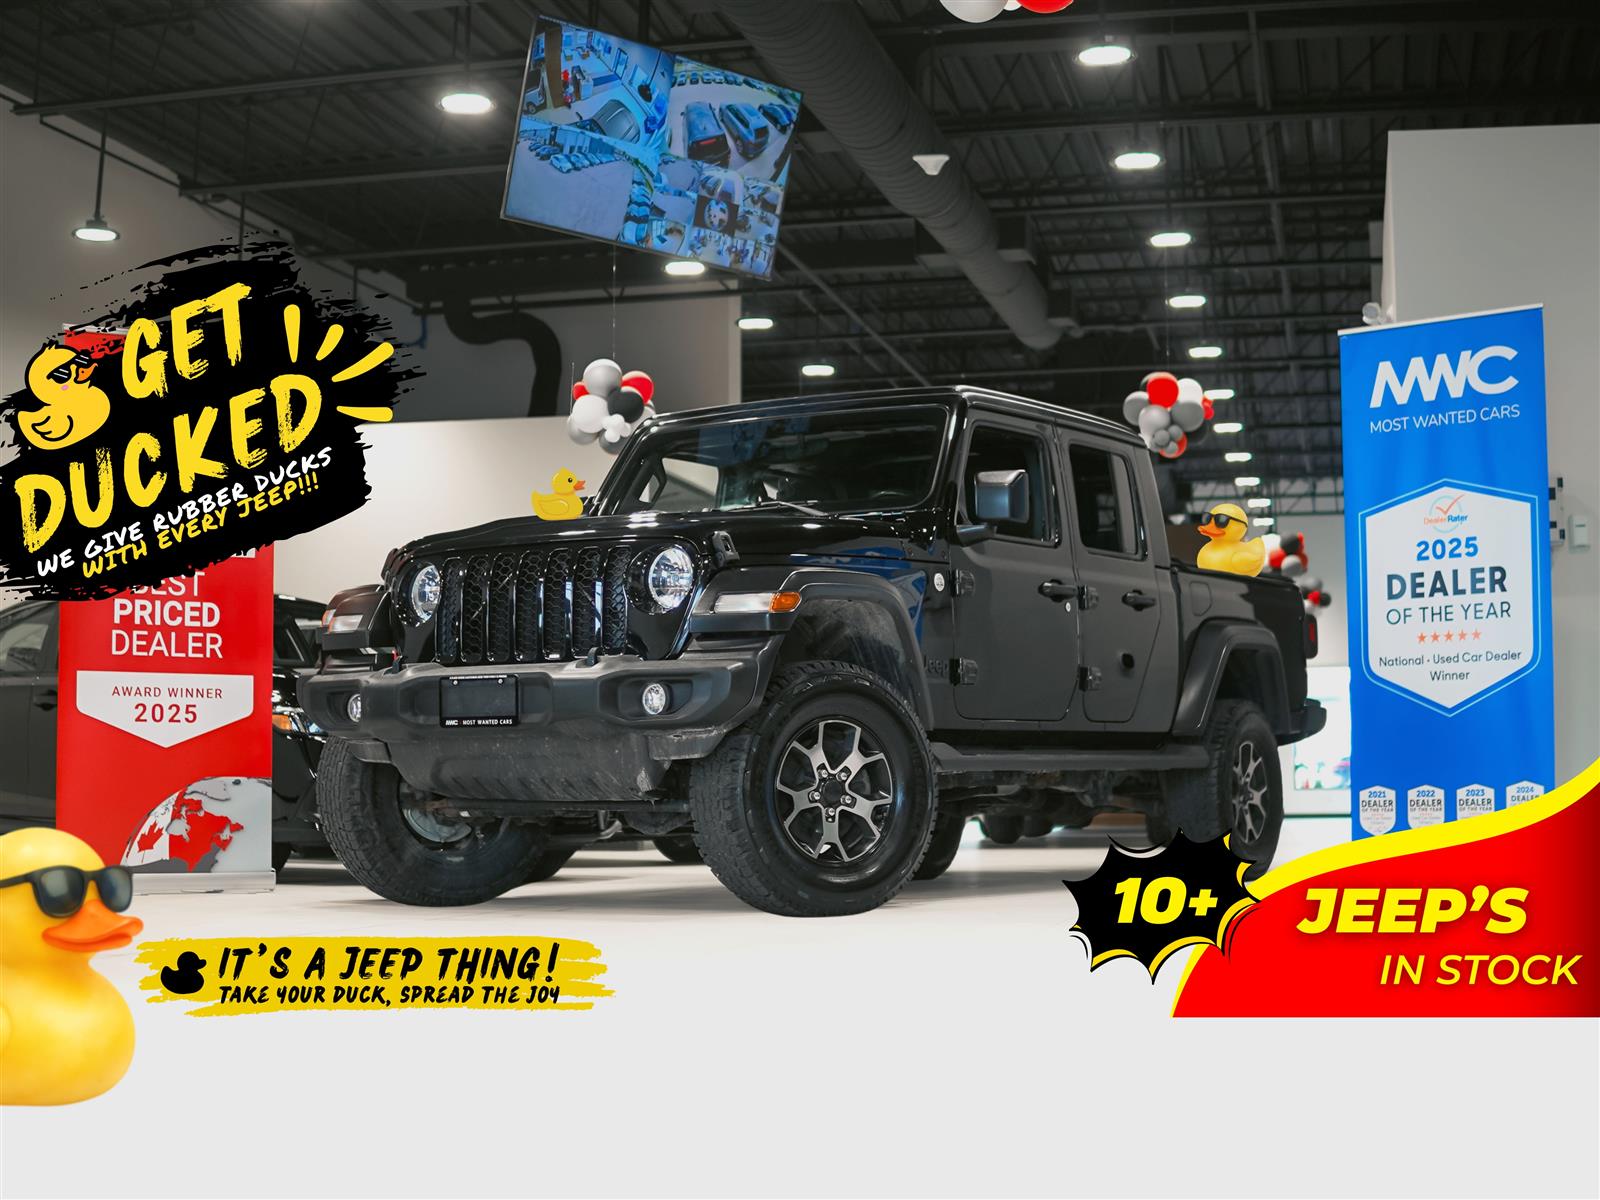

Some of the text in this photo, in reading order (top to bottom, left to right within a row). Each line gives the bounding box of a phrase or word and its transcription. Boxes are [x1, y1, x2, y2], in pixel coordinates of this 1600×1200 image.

[1369, 345, 1519, 408] MWC
[1370, 404, 1521, 433] MOST WANTED CARS
[1416, 536, 1479, 561] 2025
[1386, 565, 1508, 601] DEALER
[113, 598, 221, 628] PRICED
[1386, 601, 1511, 625] OF THE YEAR
[111, 629, 223, 659] DEALER
[1379, 650, 1522, 667] National Used Car Dealer
[1430, 670, 1470, 682] Winner
[112, 686, 223, 699] AWARD WINNER
[134, 703, 198, 723] 2025
[1410, 799, 1442, 807] DEALER
